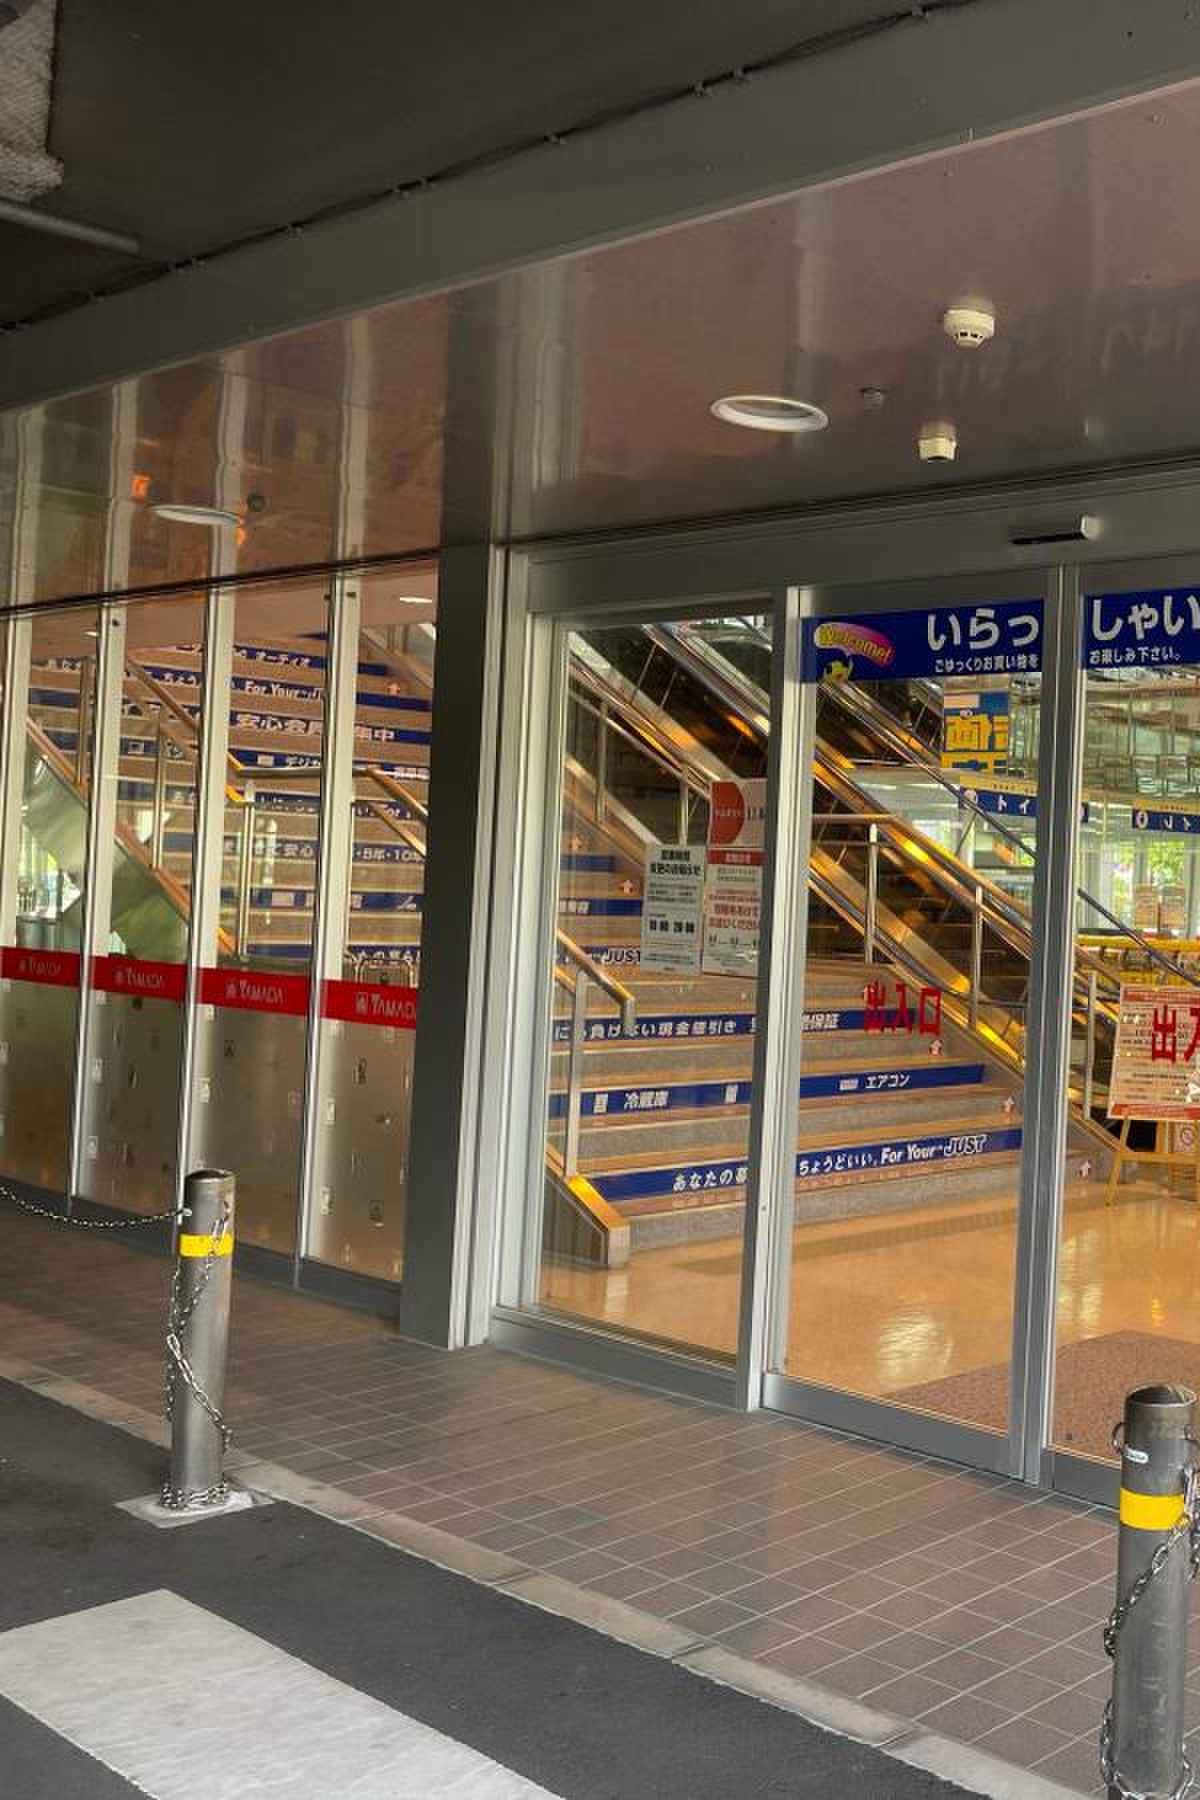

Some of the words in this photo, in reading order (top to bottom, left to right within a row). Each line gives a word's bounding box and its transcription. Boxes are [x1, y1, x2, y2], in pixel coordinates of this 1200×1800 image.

[928, 608, 1040, 651] いらっ
[239, 982, 284, 1004] YAMADA
[371, 993, 417, 1019] YAMAD
[865, 1073, 911, 1090] エアコン
[880, 1147, 903, 1165] For
[906, 1143, 936, 1161] Your
[943, 1134, 988, 1158] JUST
